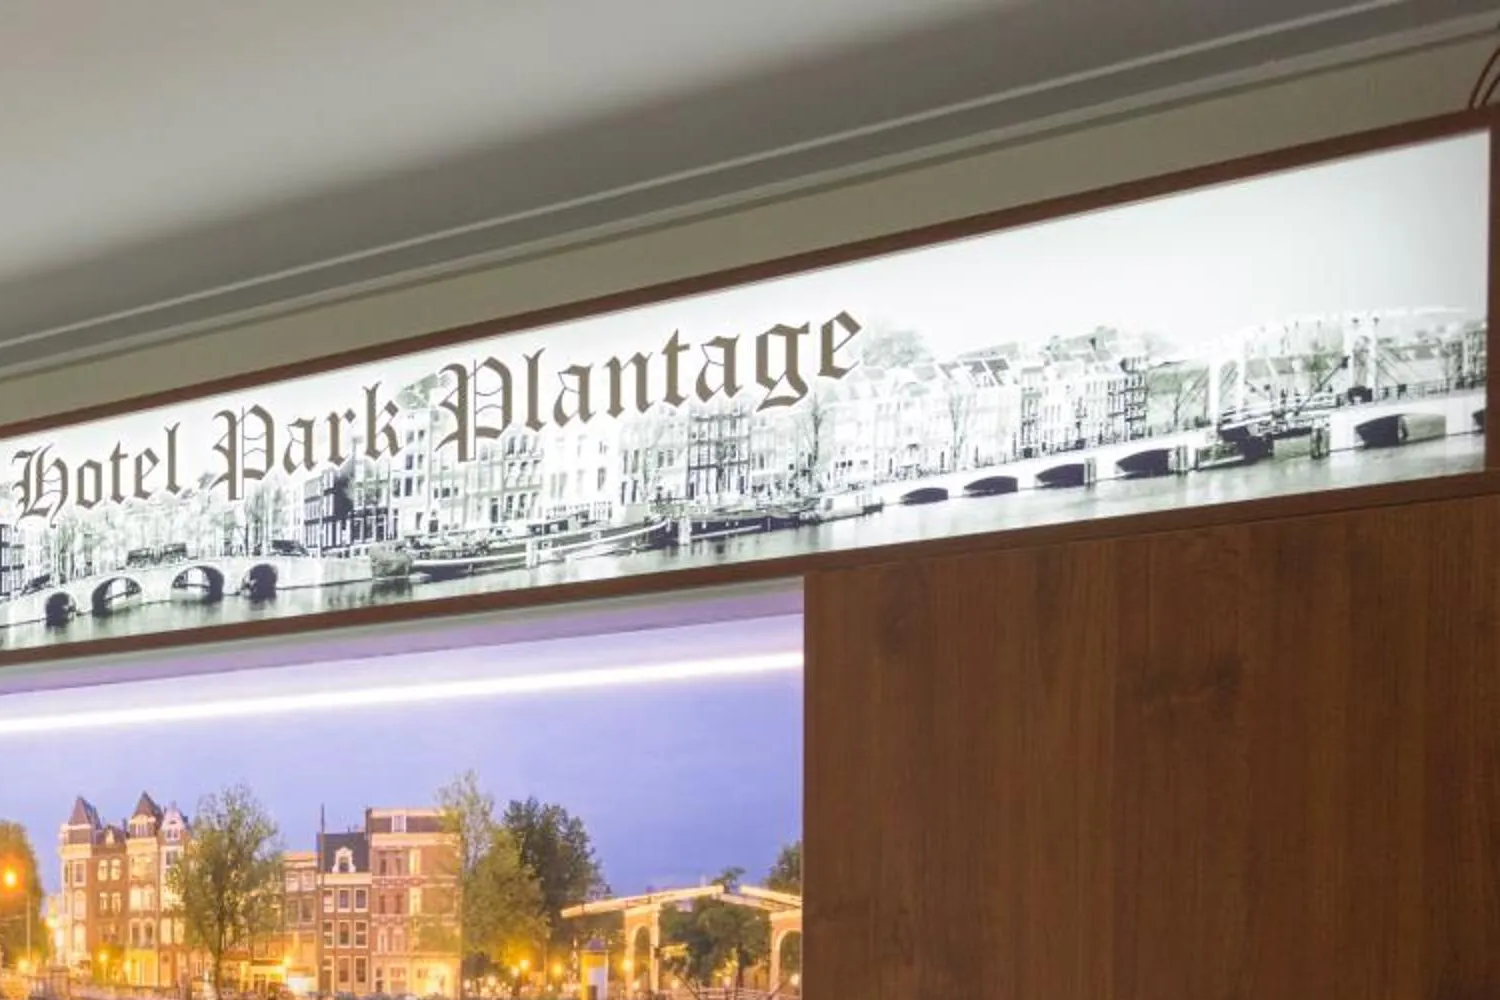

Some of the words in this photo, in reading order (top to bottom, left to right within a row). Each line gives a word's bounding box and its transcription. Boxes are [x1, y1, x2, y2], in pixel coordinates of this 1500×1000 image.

[11, 421, 182, 529] Hotel
[210, 380, 406, 500] Park
[434, 309, 863, 462] Plantage
